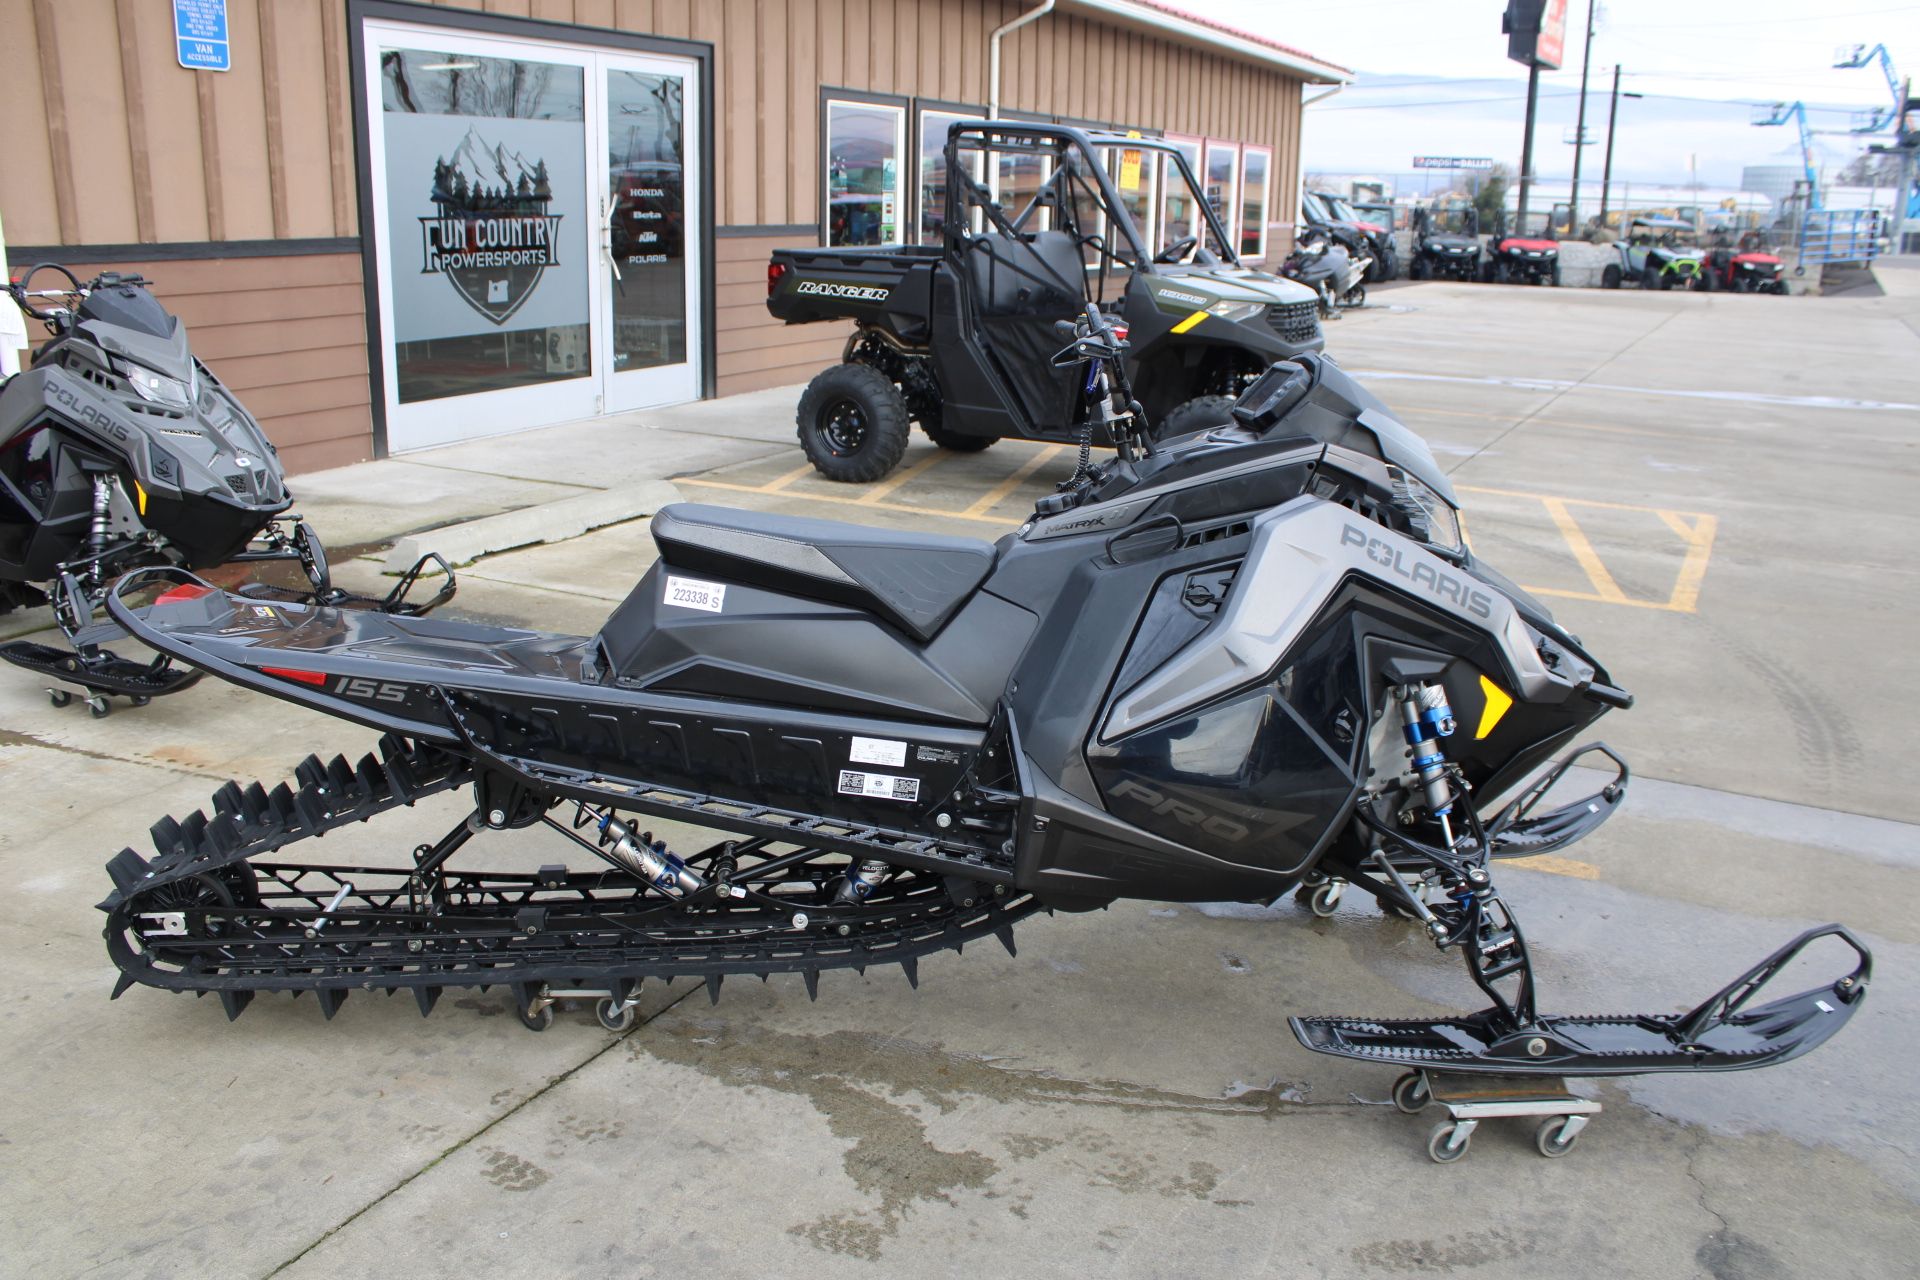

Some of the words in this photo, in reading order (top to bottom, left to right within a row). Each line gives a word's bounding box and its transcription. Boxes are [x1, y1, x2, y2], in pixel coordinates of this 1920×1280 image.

[195, 43, 213, 54] VAN
[630, 188, 664, 197] HONDA
[633, 211, 661, 219] Beta
[417, 217, 468, 273] FUN
[475, 215, 564, 266] COUNTRY
[442, 249, 546, 269] POWERSPORTS
[629, 255, 667, 264] POLARIS
[798, 281, 889, 301] RANGER
[43, 380, 129, 442] POLARIS
[1340, 523, 1492, 619] POLARIS
[673, 588, 709, 604] 223338
[711, 597, 720, 608] S
[334, 677, 408, 702] 155
[1107, 779, 1249, 842] PRO
